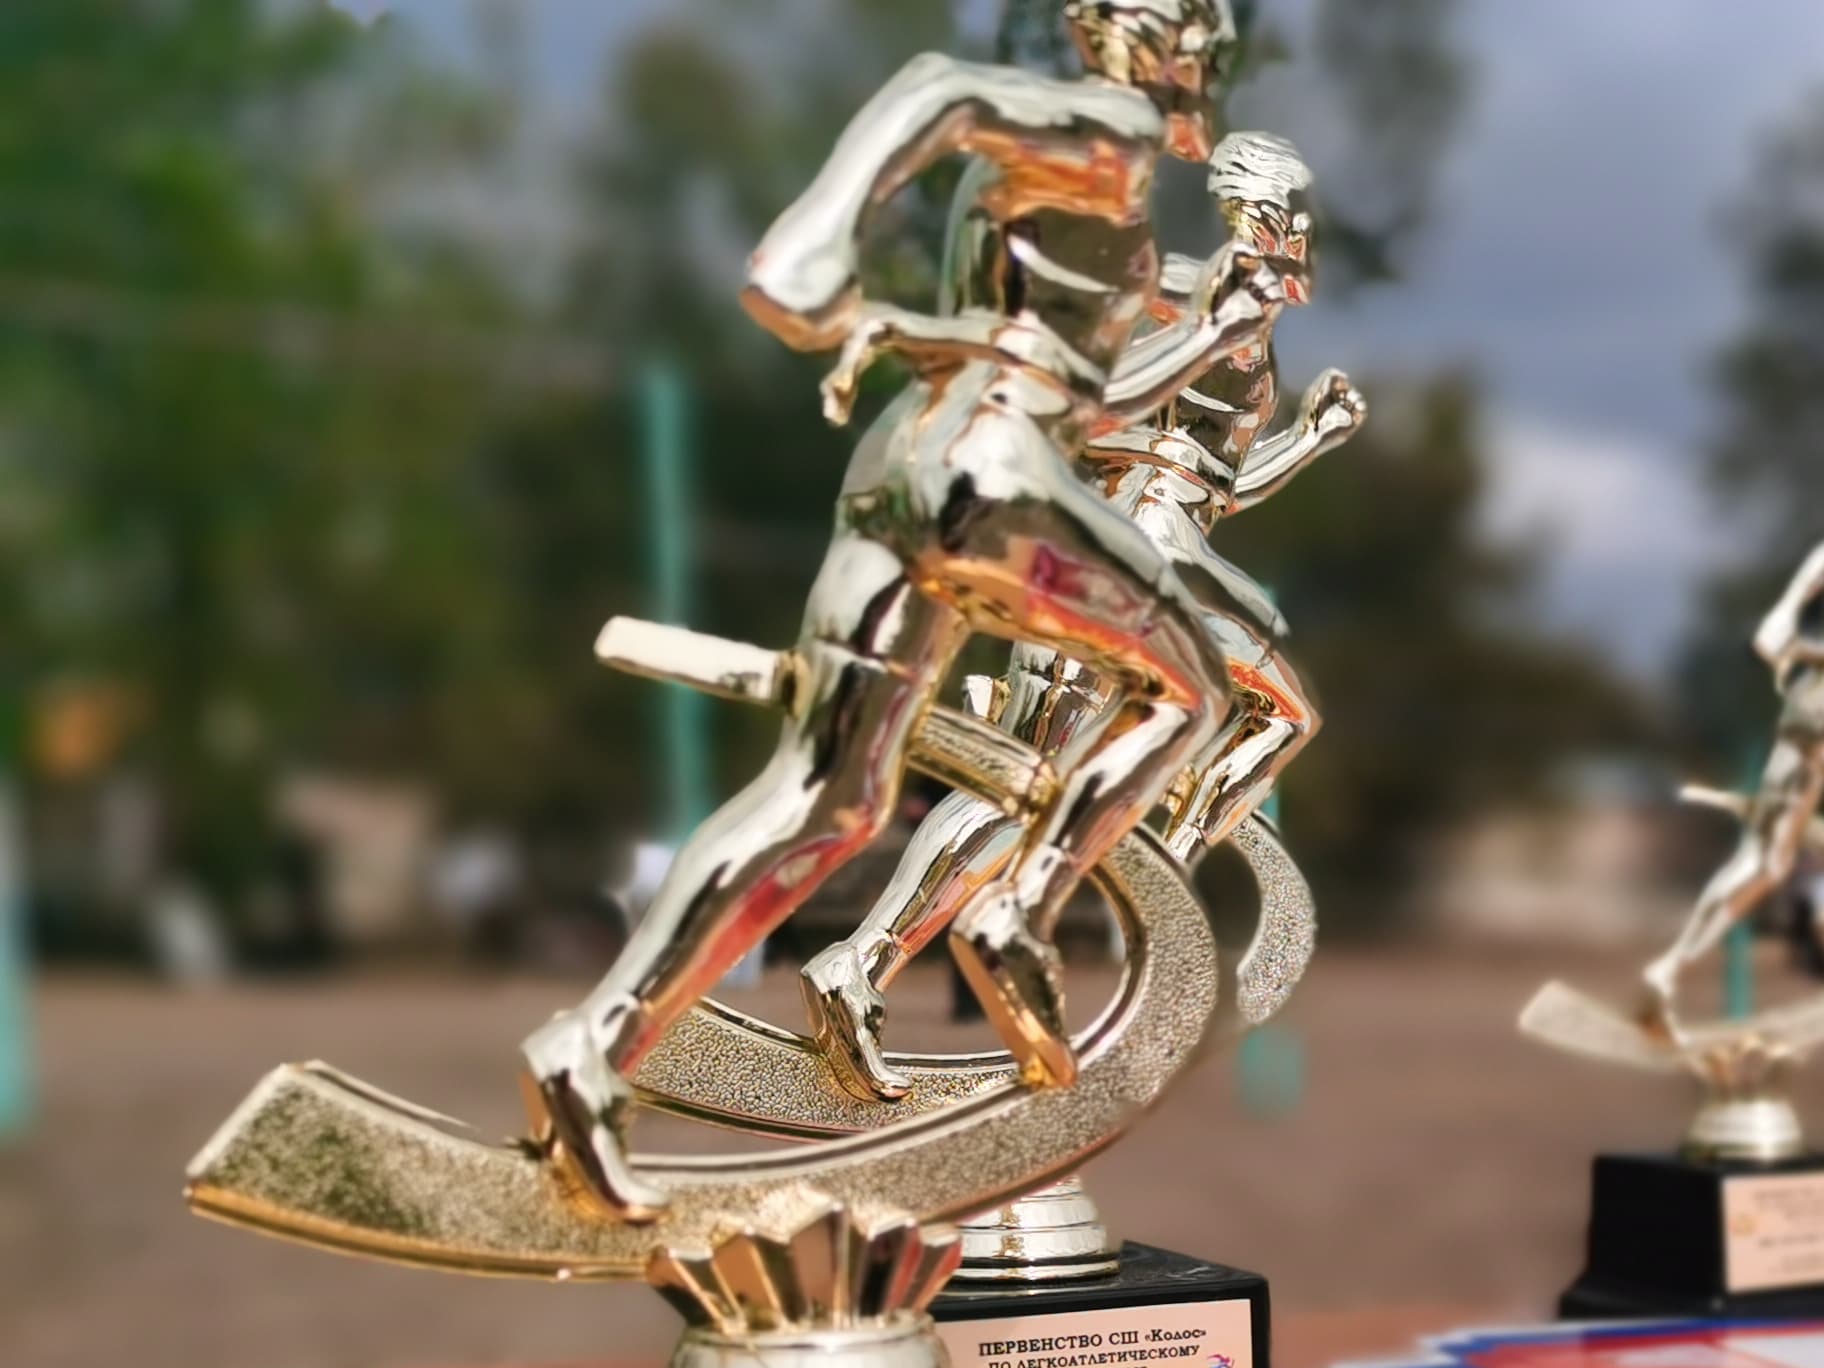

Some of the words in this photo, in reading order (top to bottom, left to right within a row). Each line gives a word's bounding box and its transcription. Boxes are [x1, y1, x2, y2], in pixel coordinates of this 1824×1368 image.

[978, 1334, 1103, 1357] ПЕРВЕНСТВО
[1108, 1330, 1139, 1346] СШ
[1144, 1328, 1206, 1342] «Колос»
